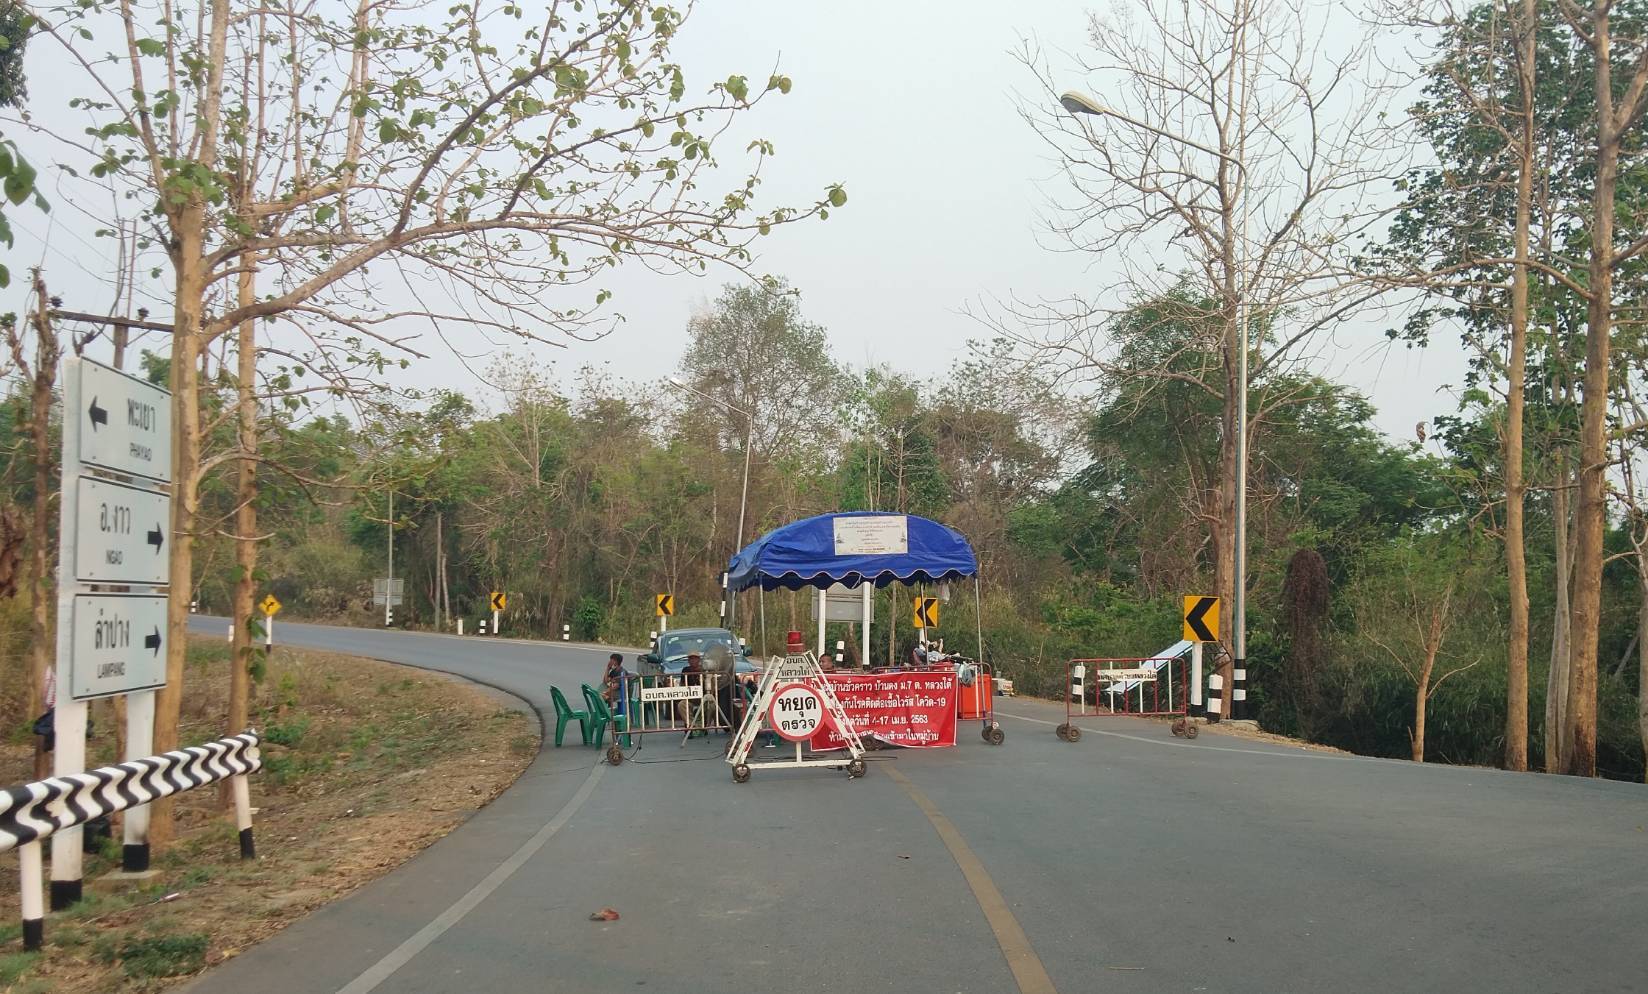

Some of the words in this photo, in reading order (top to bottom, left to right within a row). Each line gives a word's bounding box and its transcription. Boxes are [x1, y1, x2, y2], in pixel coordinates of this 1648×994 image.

[128, 398, 156, 433] พะเยา
[129, 442, 153, 462] PHAYAO
[101, 503, 131, 535] อ.งาว
[105, 549, 124, 565] NGAO
[95, 608, 130, 650] ลำปาง
[97, 662, 126, 680] LAMPANG
[778, 696, 817, 717] หยุด
[781, 719, 816, 731] ตรวจ
[911, 714, 929, 724] 2563
